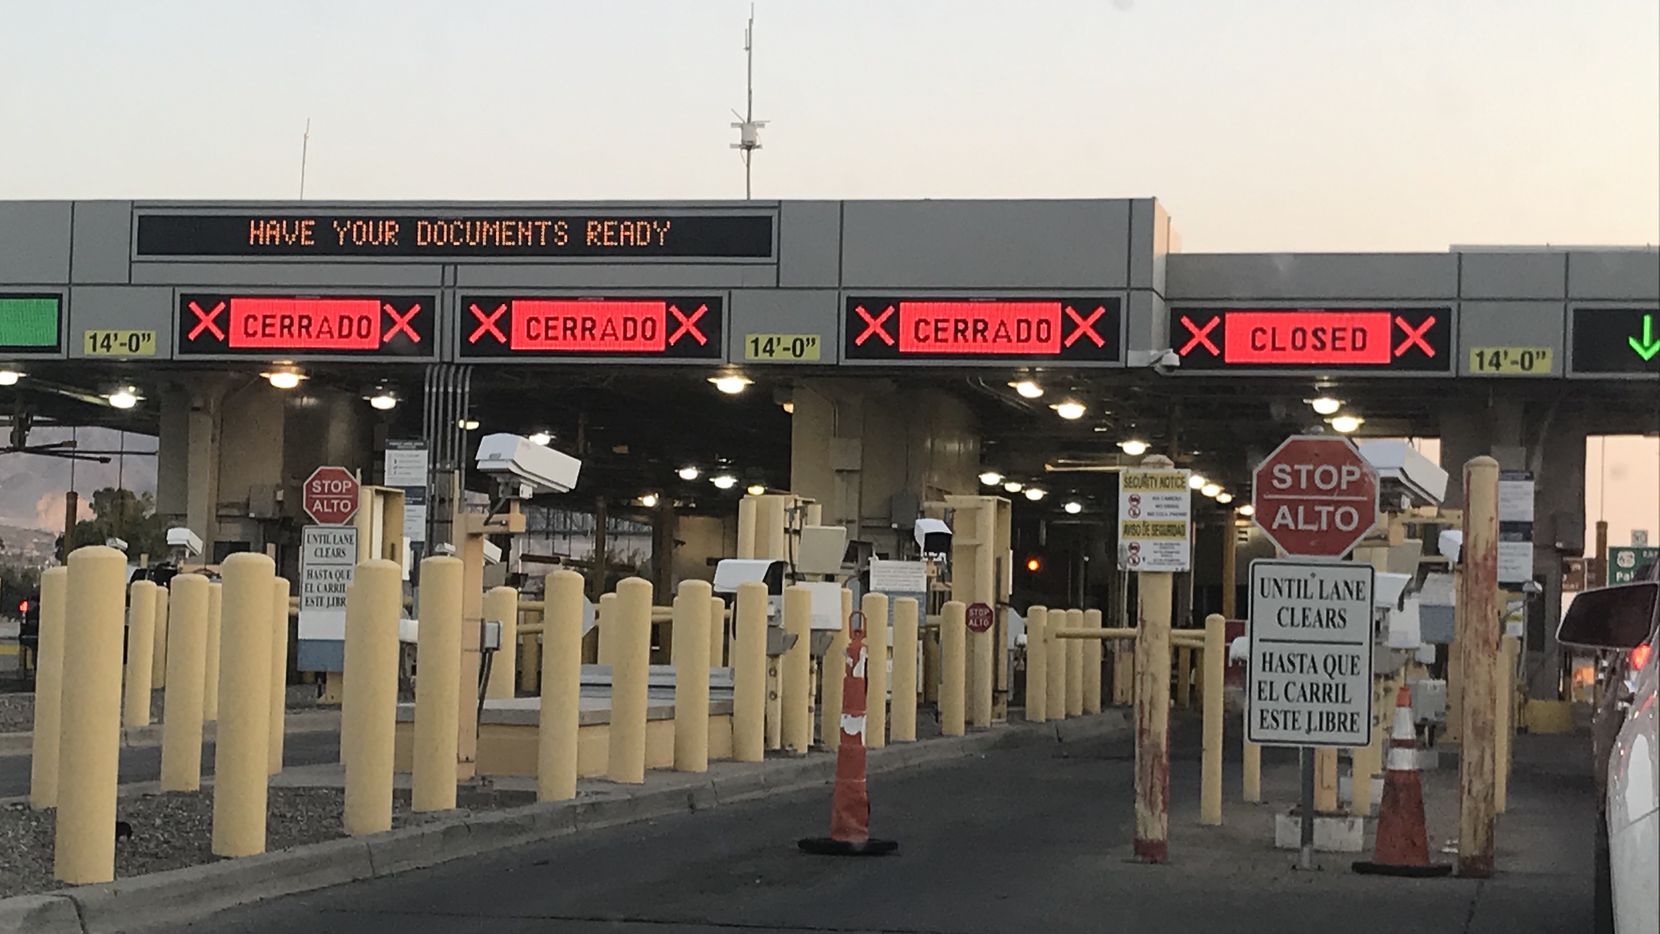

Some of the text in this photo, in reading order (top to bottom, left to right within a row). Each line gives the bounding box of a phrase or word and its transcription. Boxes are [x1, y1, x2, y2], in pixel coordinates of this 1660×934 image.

[249, 219, 671, 247] HAVE YOUR DOCUMENTS READY
[243, 313, 373, 340] CERRADO
[526, 316, 657, 342] CERRADO
[913, 317, 1051, 344] CERRADO
[1250, 326, 1368, 352] CLOSED
[312, 480, 352, 494] STOP
[1123, 473, 1186, 489] SECURITY NOTICE
[1271, 463, 1361, 490] STOP
[312, 500, 352, 513] ALTO
[1271, 505, 1360, 532] ALTO
[306, 534, 354, 546] UNTIL LANE
[313, 547, 347, 559] CLEARS
[306, 569, 352, 583] HASTA QUE
[1260, 577, 1366, 602] UNTIL LANE
[968, 608, 990, 616] STOP
[968, 618, 990, 627] ALTO
[1276, 606, 1347, 630] CLEARS
[1261, 651, 1361, 680] HASTA QUE
[1257, 680, 1352, 705] EL CARRIL
[1259, 708, 1360, 735] ESTE LIBRE
